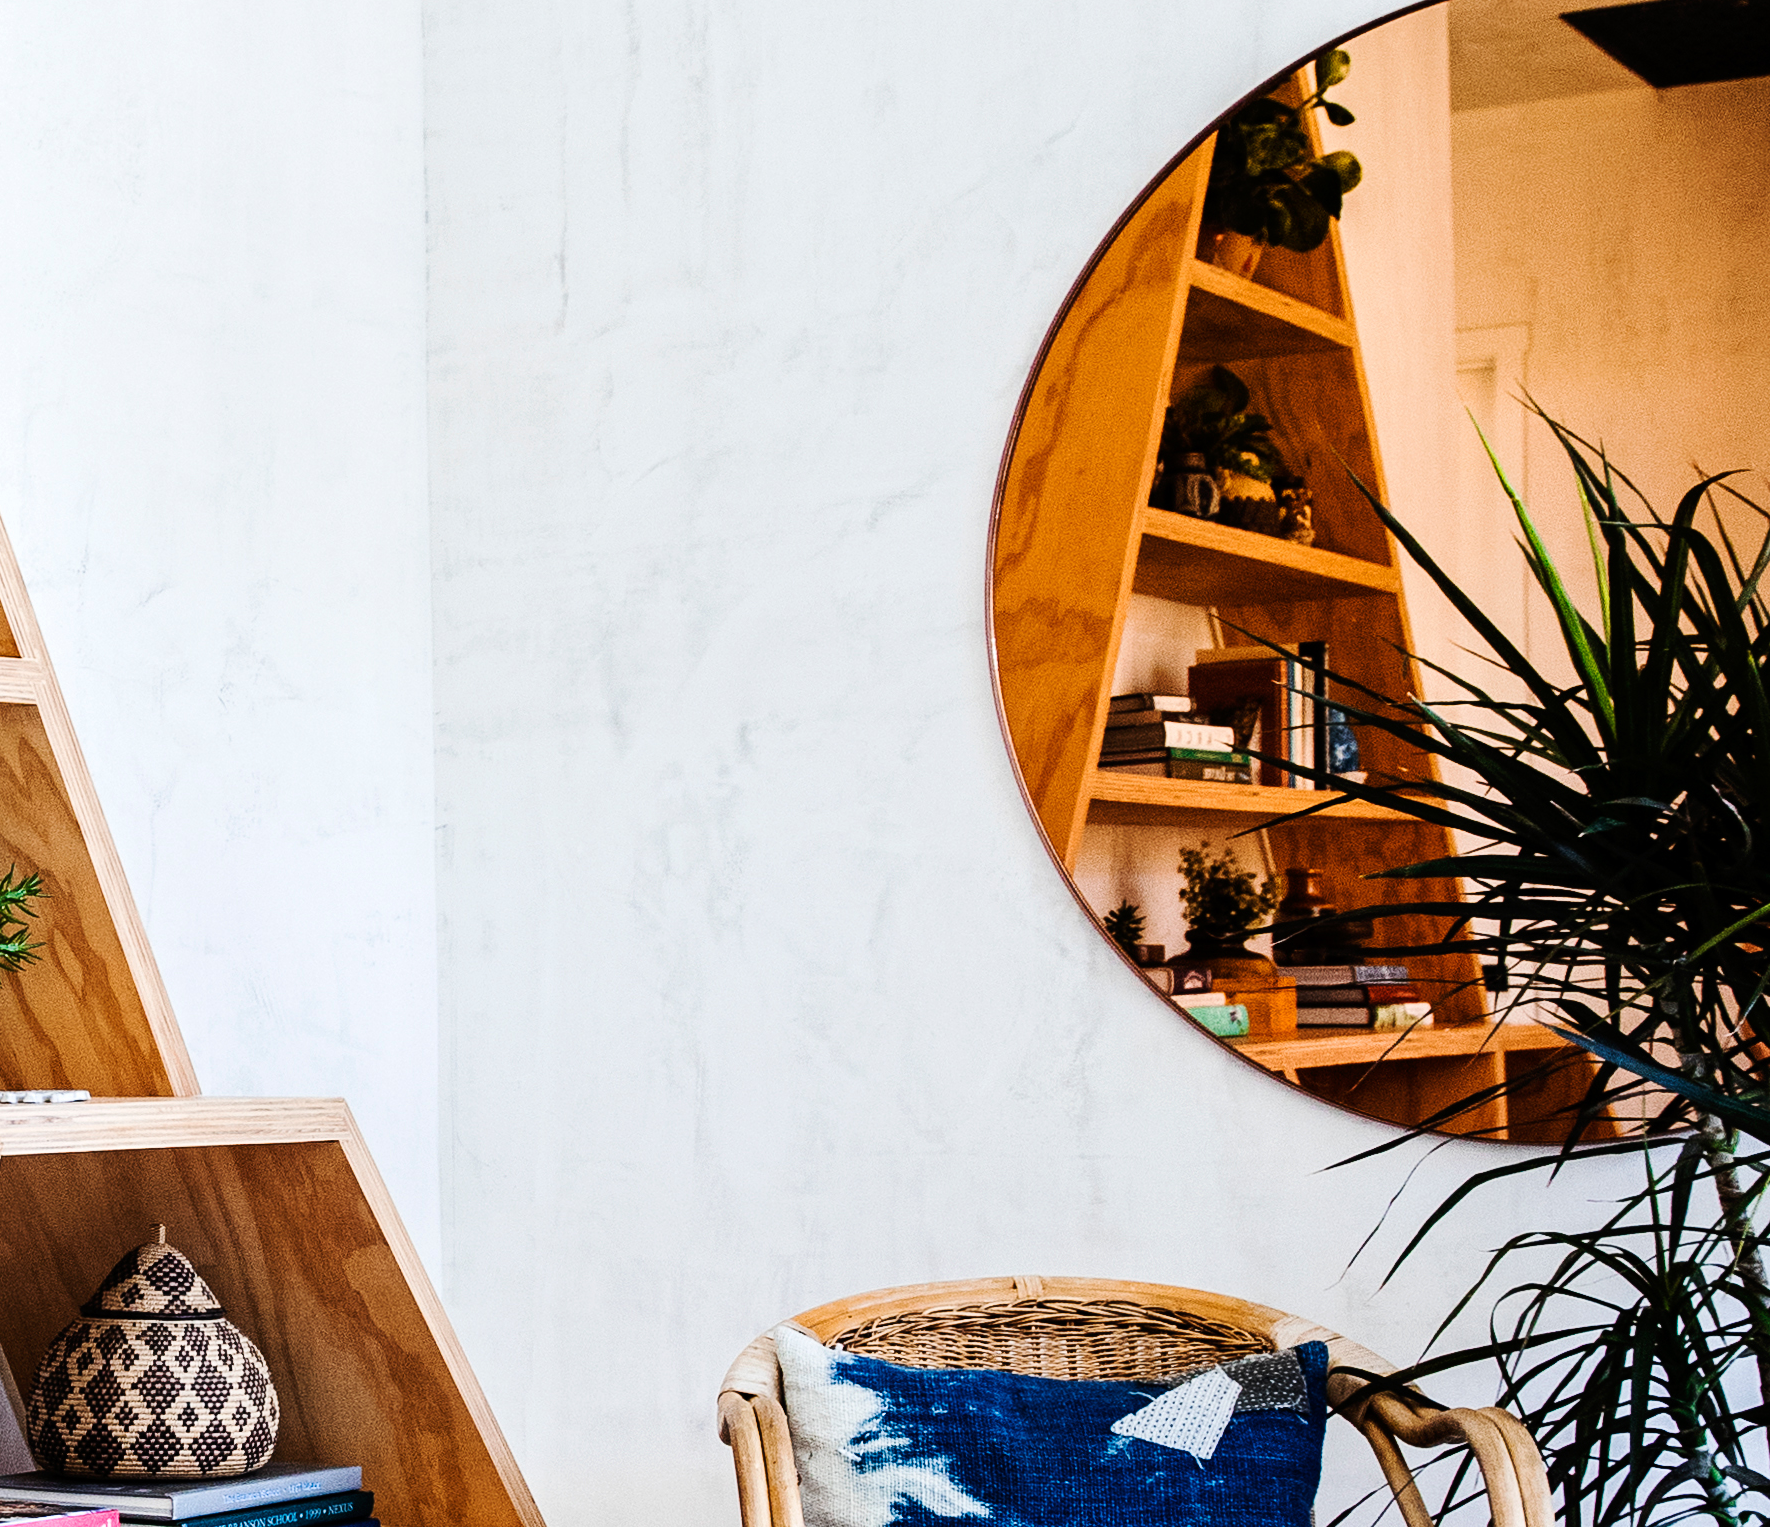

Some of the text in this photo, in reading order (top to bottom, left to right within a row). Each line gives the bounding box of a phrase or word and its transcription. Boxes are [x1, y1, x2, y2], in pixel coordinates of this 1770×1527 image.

[267, 1511, 298, 1527] SCHOOL
[305, 1507, 322, 1520] 1999
[328, 1501, 354, 1516] NEXUS
